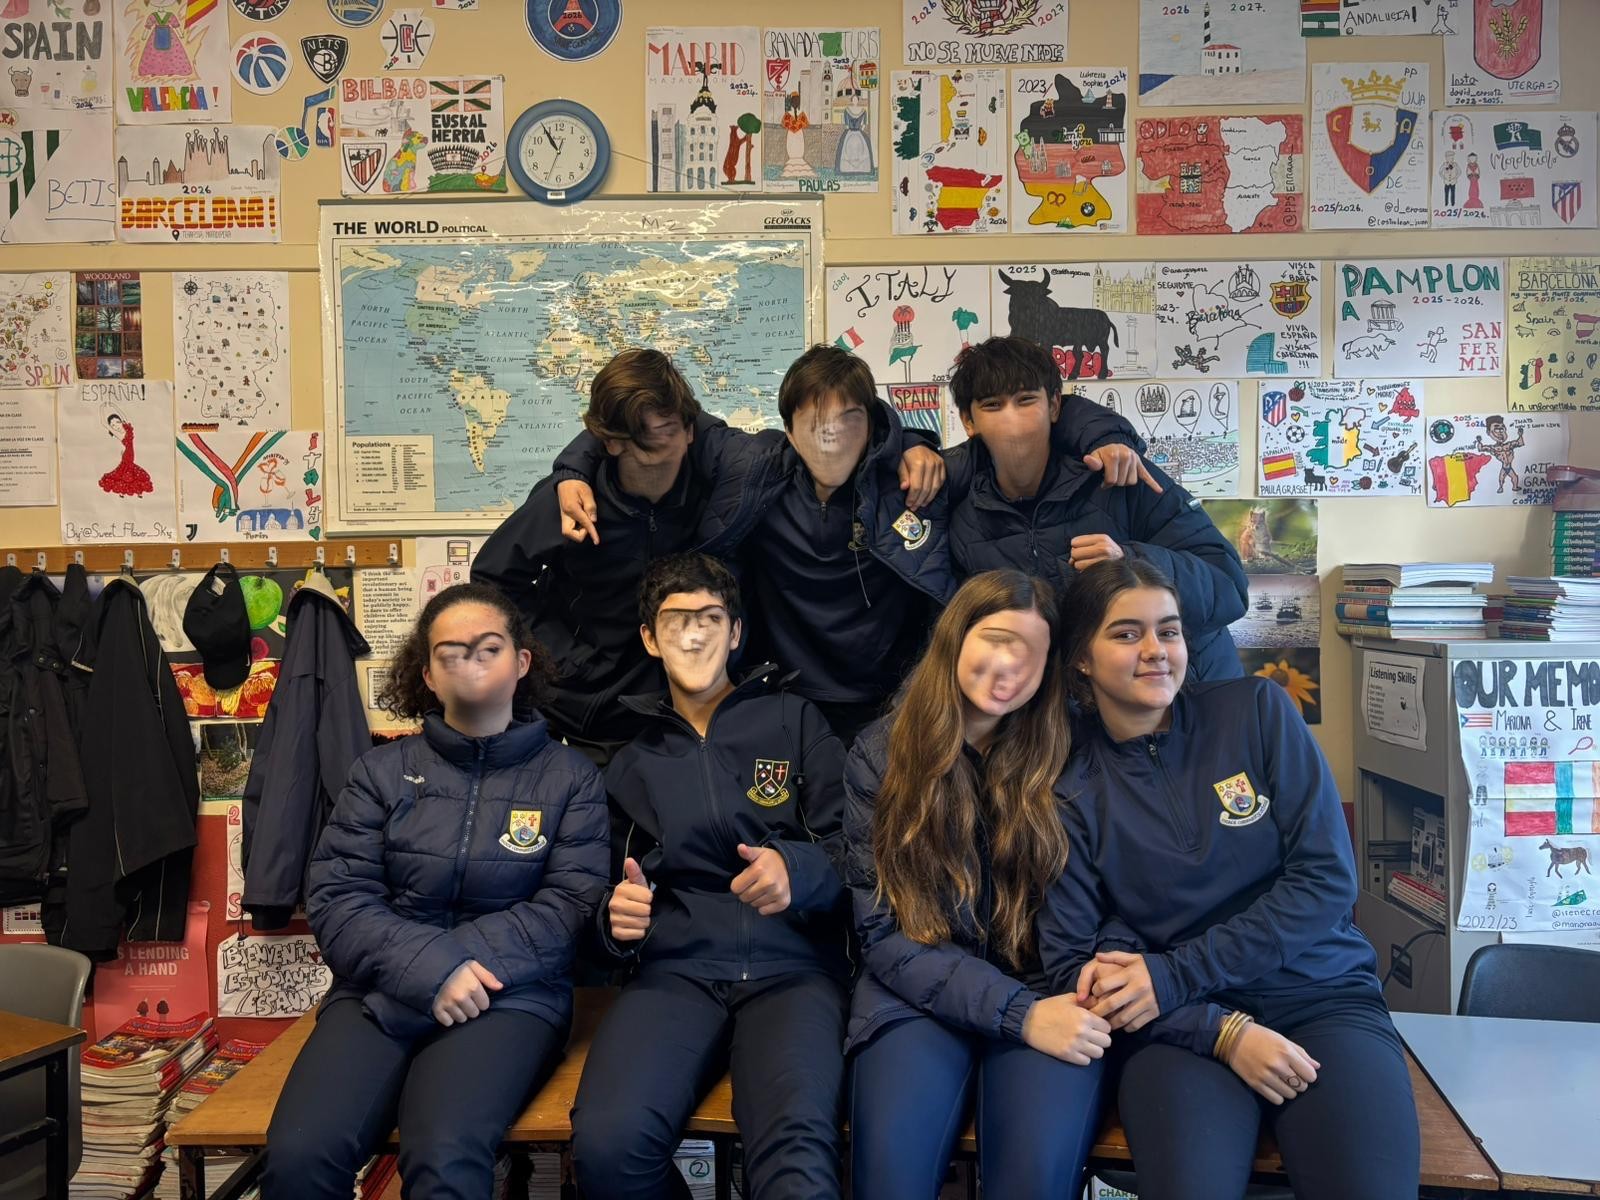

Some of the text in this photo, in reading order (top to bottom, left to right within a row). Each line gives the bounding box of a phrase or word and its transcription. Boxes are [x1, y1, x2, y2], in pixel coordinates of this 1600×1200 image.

[911, 0, 1064, 26] 2026 2027
[1163, 6, 1190, 16] 2026
[2, 21, 103, 61] SPAIN
[306, 40, 341, 51] NETS
[763, 31, 879, 59] GRANADA TURIS
[908, 41, 1064, 63] NO SE MUEVE NADIE
[648, 42, 745, 76] MADRID
[1104, 71, 1127, 89] 2024
[342, 78, 427, 102] BILBAO
[1508, 81, 1545, 91] UTERGA
[431, 114, 487, 129] EUSKAL
[554, 123, 564, 132] 12
[431, 129, 486, 143] HERRIA
[532, 137, 543, 146] 10
[580, 136, 586, 144] 2
[528, 149, 534, 158] 9
[584, 149, 590, 158] 3
[532, 162, 539, 171] 8
[579, 162, 585, 171] 4
[556, 174, 562, 184] 6
[568, 172, 575, 181] 5
[182, 185, 212, 197] 2026
[121, 196, 277, 230] BARCELONA!
[764, 216, 811, 225] GEOPACKS
[989, 218, 1008, 226] 2026
[333, 220, 487, 235] THE WORLD POLITICAL
[1008, 265, 1037, 274] 2025
[1289, 262, 1316, 270] VISCA
[84, 272, 132, 280] WOODLAND
[1342, 263, 1500, 298] PAMPLON
[1519, 272, 1599, 290] BARCELONA
[845, 266, 957, 319] ITALY
[758, 298, 788, 307] NORTH
[1412, 296, 1443, 304] 2025
[360, 304, 391, 313] NORTH
[1341, 301, 1361, 322] A
[759, 313, 796, 324] PACIFIC
[1526, 312, 1556, 326] Spain
[351, 320, 389, 329] PACIFIC
[484, 330, 530, 338] ATLANTIC
[765, 330, 795, 339] OCEAN
[1281, 330, 1317, 341] ESPAÑA
[1461, 322, 1502, 339] SAN
[358, 336, 388, 344] OCEAN
[1459, 343, 1498, 356] FER
[1459, 356, 1500, 372] MIN
[1549, 367, 1584, 380] Ireland
[399, 376, 429, 384] SOUTH
[82, 381, 146, 402] ESPAÑA!
[396, 392, 433, 401] PACIFIC
[894, 388, 938, 411] SPAIN
[399, 407, 432, 415] OCEAN
[352, 441, 391, 450] Populations
[1370, 666, 1417, 687] Listening Skills
[1454, 660, 1518, 709] OUR
[1570, 708, 1593, 730] IRENE
[1463, 915, 1519, 930] 2022/23
[130, 946, 190, 961] LENDING
[123, 962, 178, 976] A HAND
